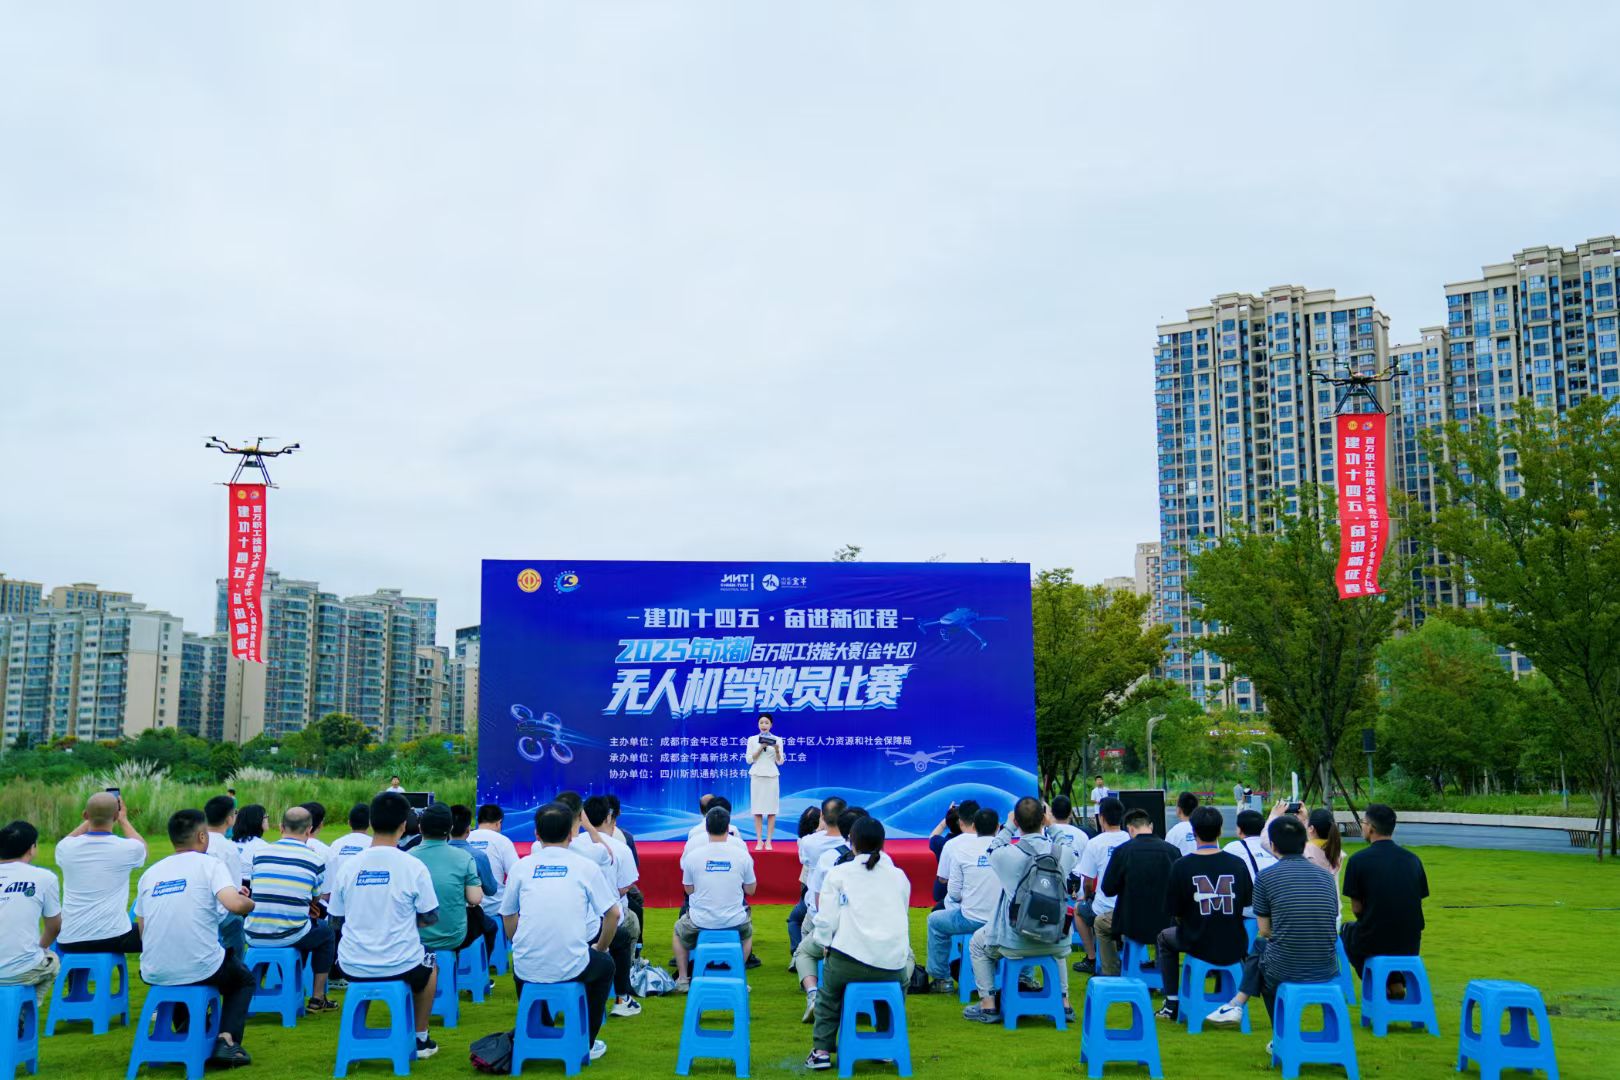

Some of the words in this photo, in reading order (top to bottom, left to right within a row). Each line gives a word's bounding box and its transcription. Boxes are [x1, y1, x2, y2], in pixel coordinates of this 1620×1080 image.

[602, 664, 913, 718] 无人机驾驶员比赛
[609, 736, 653, 747] 主办单位：
[660, 736, 748, 747] 成都市金牛区总工会
[609, 752, 653, 763] 承办单位：
[609, 769, 653, 779] 协办单位：
